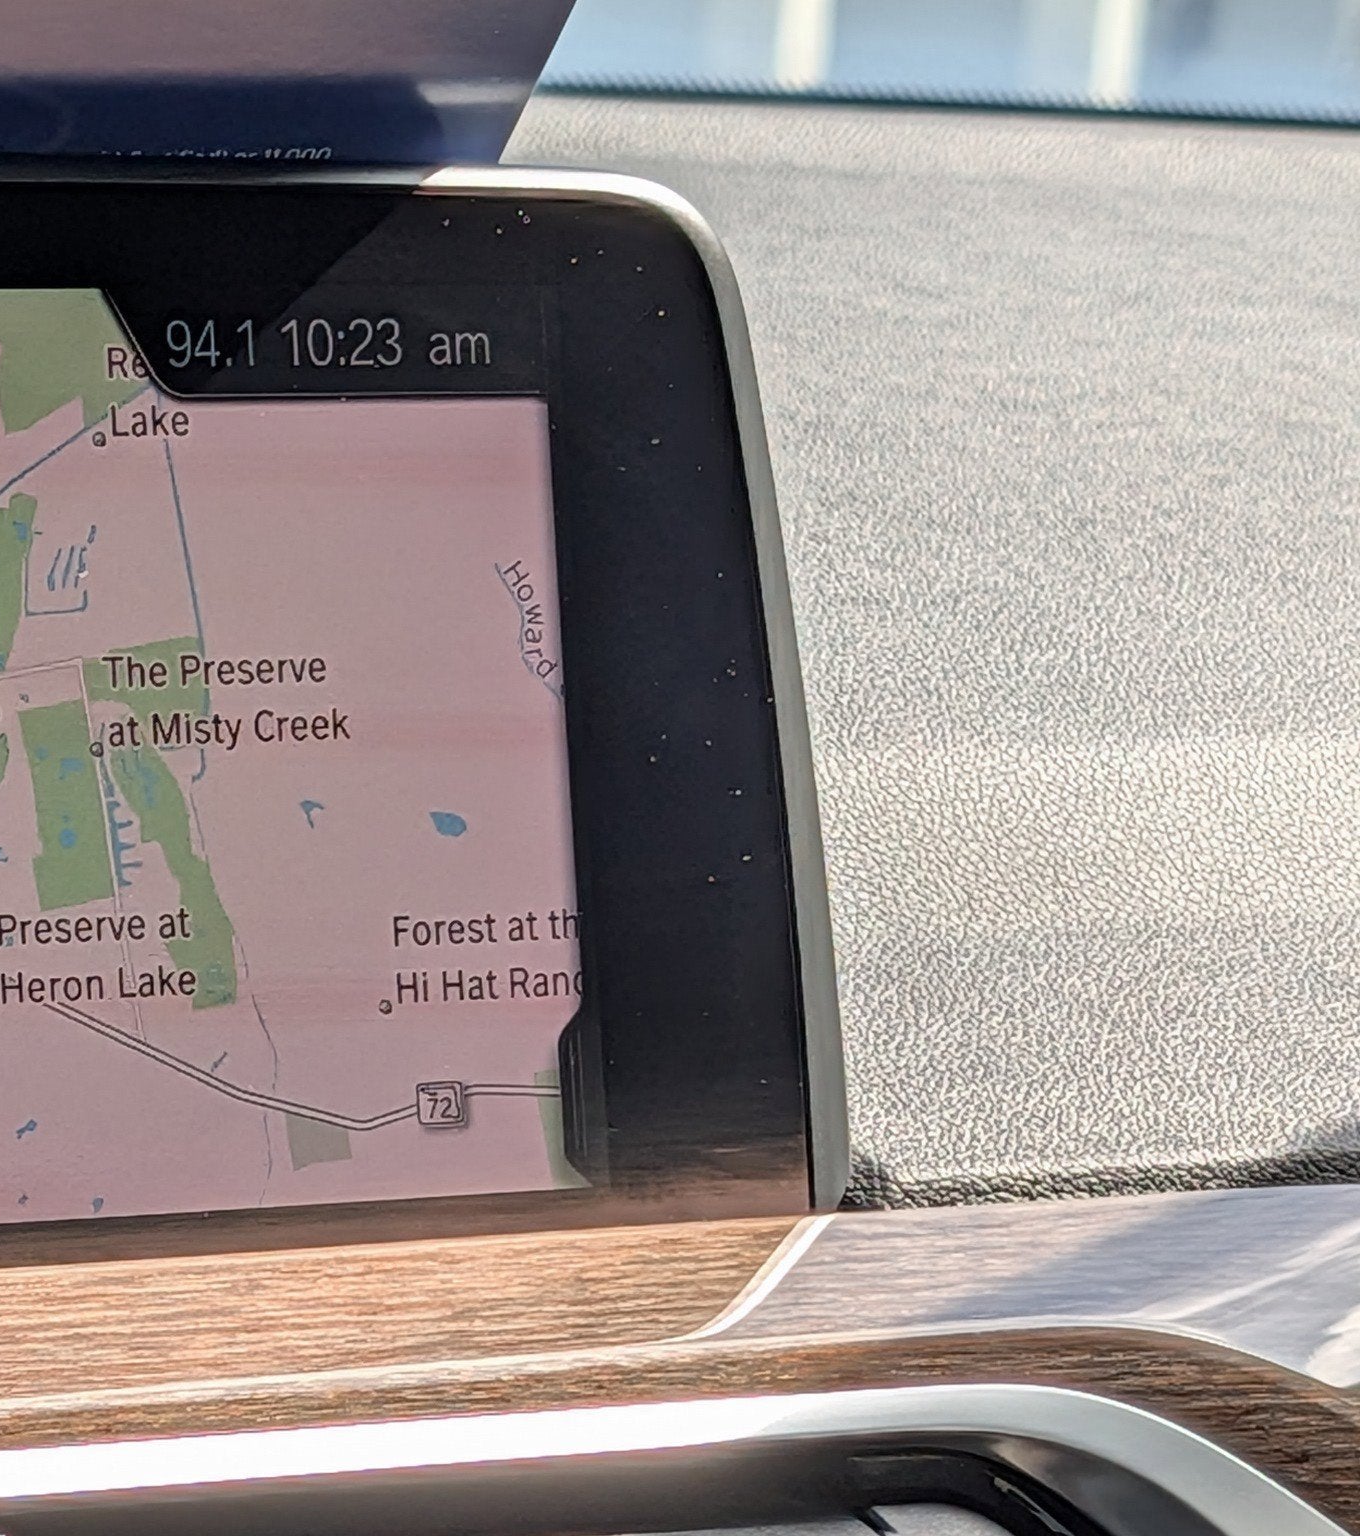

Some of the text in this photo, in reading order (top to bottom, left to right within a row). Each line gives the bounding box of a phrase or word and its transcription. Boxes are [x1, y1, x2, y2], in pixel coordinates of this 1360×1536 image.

[166, 319, 491, 368] 94.1 10:23 am
[110, 404, 190, 437] Lake
[503, 560, 558, 679] Howard
[101, 655, 326, 689] The Preserve
[109, 711, 350, 751] at Misty Creek
[160, 909, 191, 939] at
[393, 913, 498, 947] Forest
[508, 911, 539, 942] at
[0, 967, 196, 1003] Heron Lake
[397, 971, 428, 1004] Hi
[442, 970, 499, 1002] Hat
[427, 1097, 453, 1118] 72
